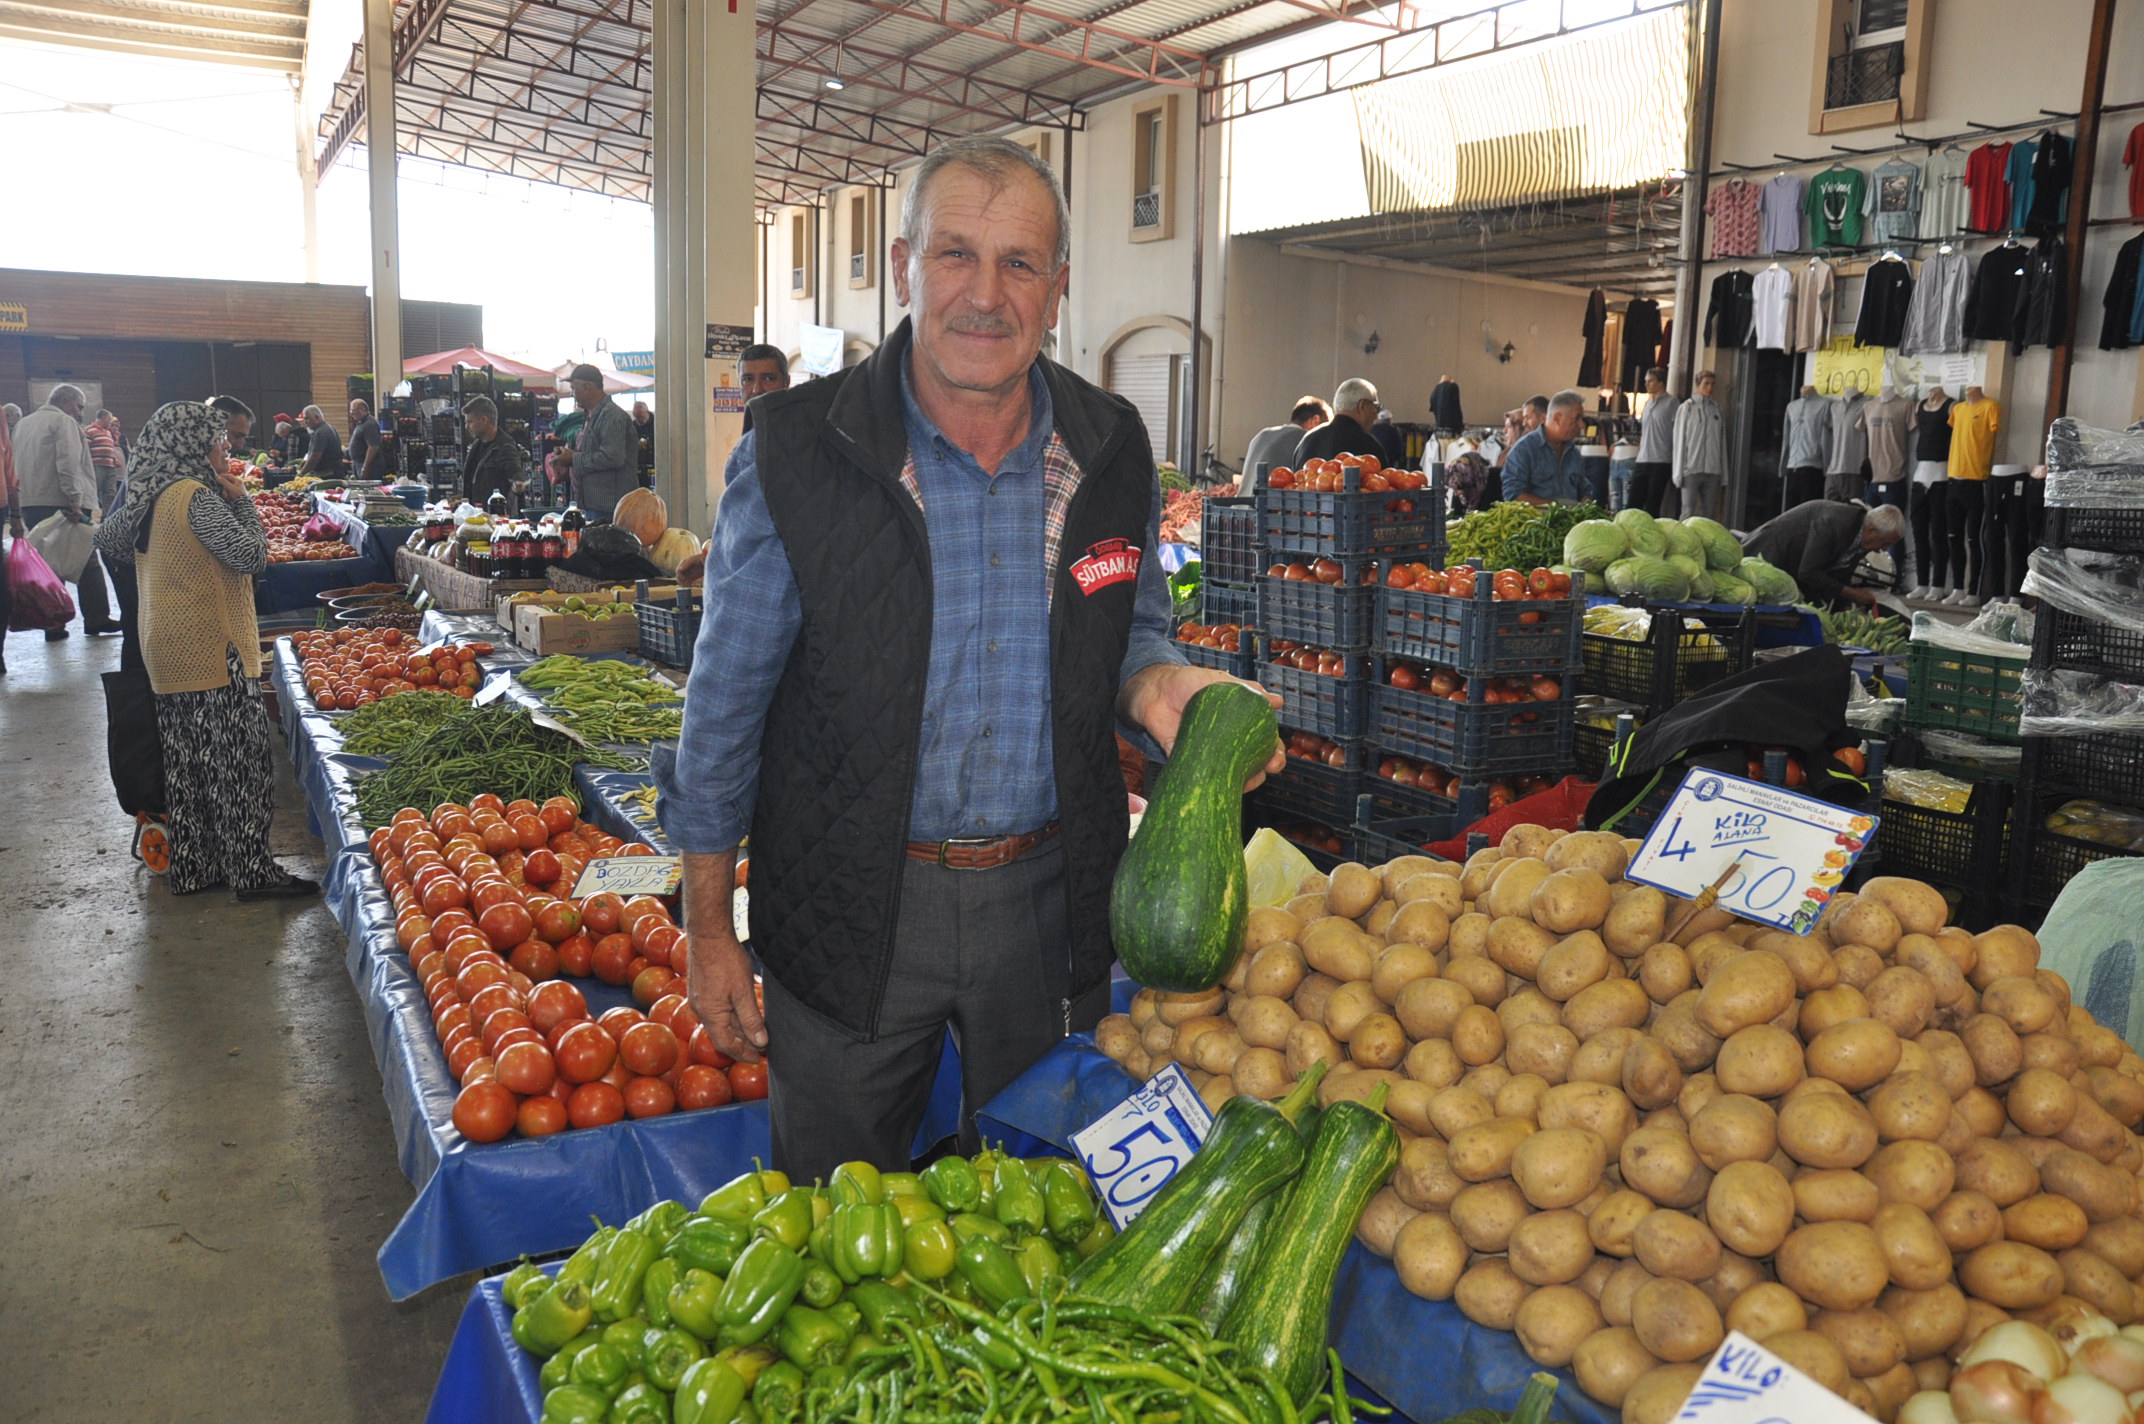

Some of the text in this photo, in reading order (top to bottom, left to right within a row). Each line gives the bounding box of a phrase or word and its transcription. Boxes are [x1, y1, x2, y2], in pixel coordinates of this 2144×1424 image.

[1077, 556, 1125, 587] SÜTBAN
[1750, 788, 1782, 804] MANAVLAR
[1790, 799, 1829, 817] PAZARCILAR
[1752, 796, 1793, 814] ESNAF ODASI
[1659, 817, 1697, 861] 4
[1713, 827, 1763, 841] ALANA
